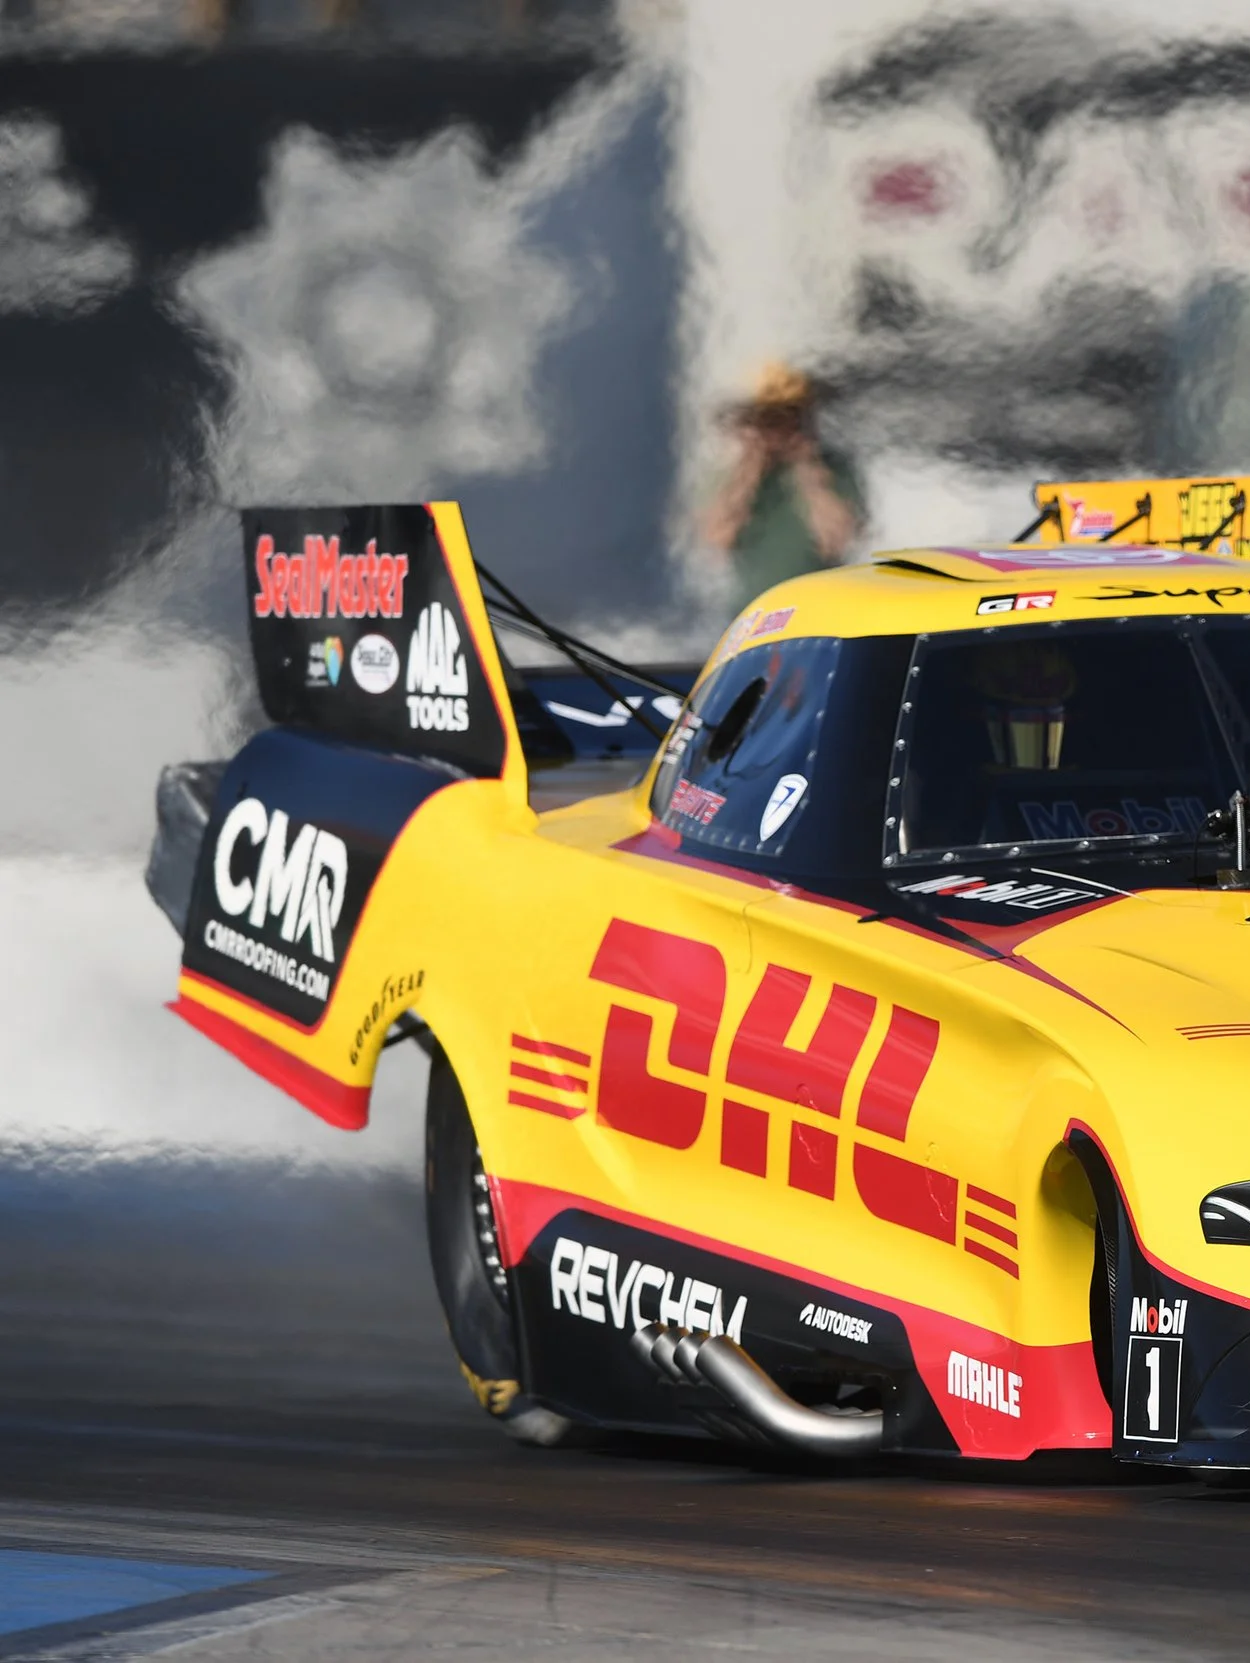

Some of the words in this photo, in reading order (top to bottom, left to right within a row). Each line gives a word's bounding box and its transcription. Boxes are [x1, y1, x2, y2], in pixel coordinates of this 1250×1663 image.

[255, 534, 409, 619] SealMaster
[976, 591, 1057, 615] GR
[406, 601, 469, 696] MAC
[406, 696, 469, 732] TOOLS
[1018, 799, 1207, 842] Mobil
[214, 797, 348, 963] CMR
[897, 874, 1054, 903] Mobil
[204, 919, 330, 1002] CMRROOFING.COM
[350, 969, 426, 1067] GOODYEAR
[589, 916, 959, 1247] DHL
[550, 1236, 748, 1346] REVCHEM
[812, 1306, 874, 1344] AUTODESK
[1130, 1296, 1188, 1335] Mobil
[947, 1350, 1022, 1419] MAHLE
[1145, 1346, 1160, 1431] 1
